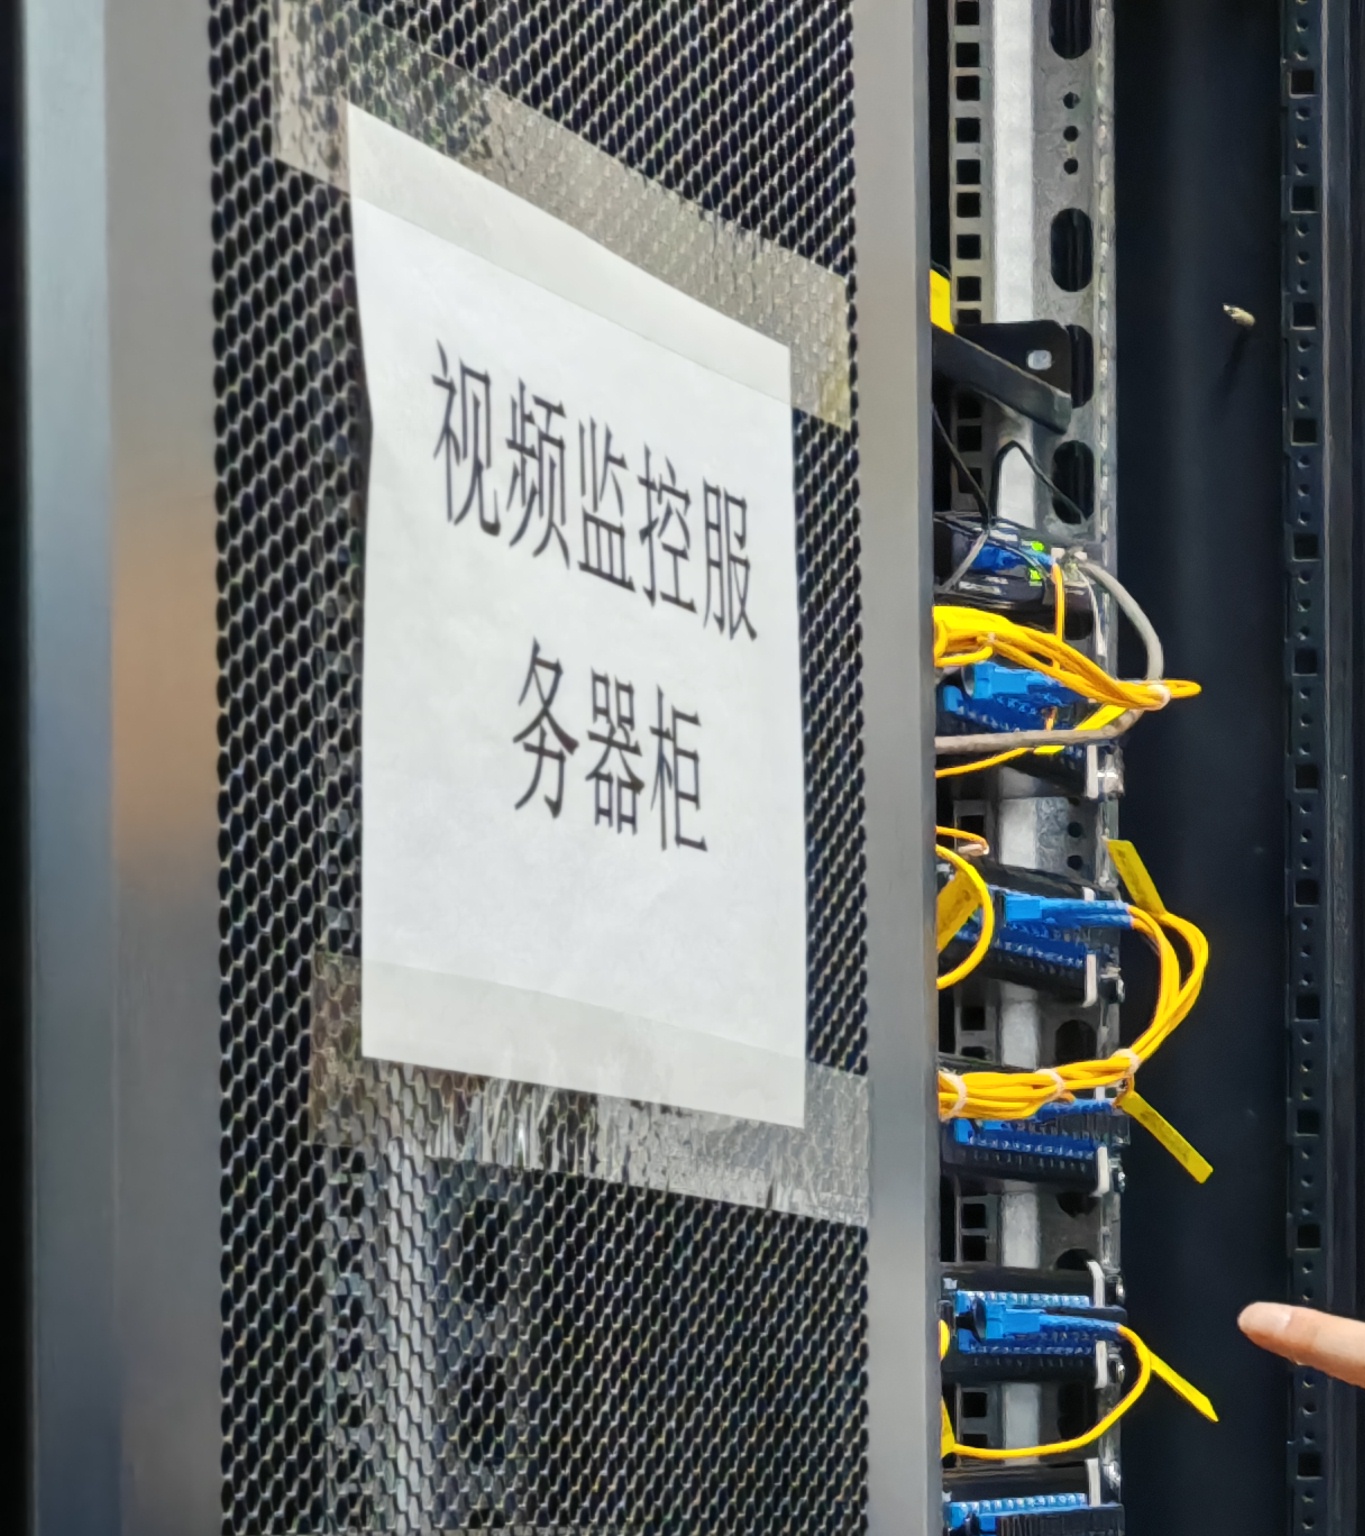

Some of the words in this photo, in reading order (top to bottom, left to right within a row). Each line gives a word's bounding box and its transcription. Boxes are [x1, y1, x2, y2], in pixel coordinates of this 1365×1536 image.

[431, 340, 758, 641] 视频监控服
[512, 638, 708, 852] 务器柜
